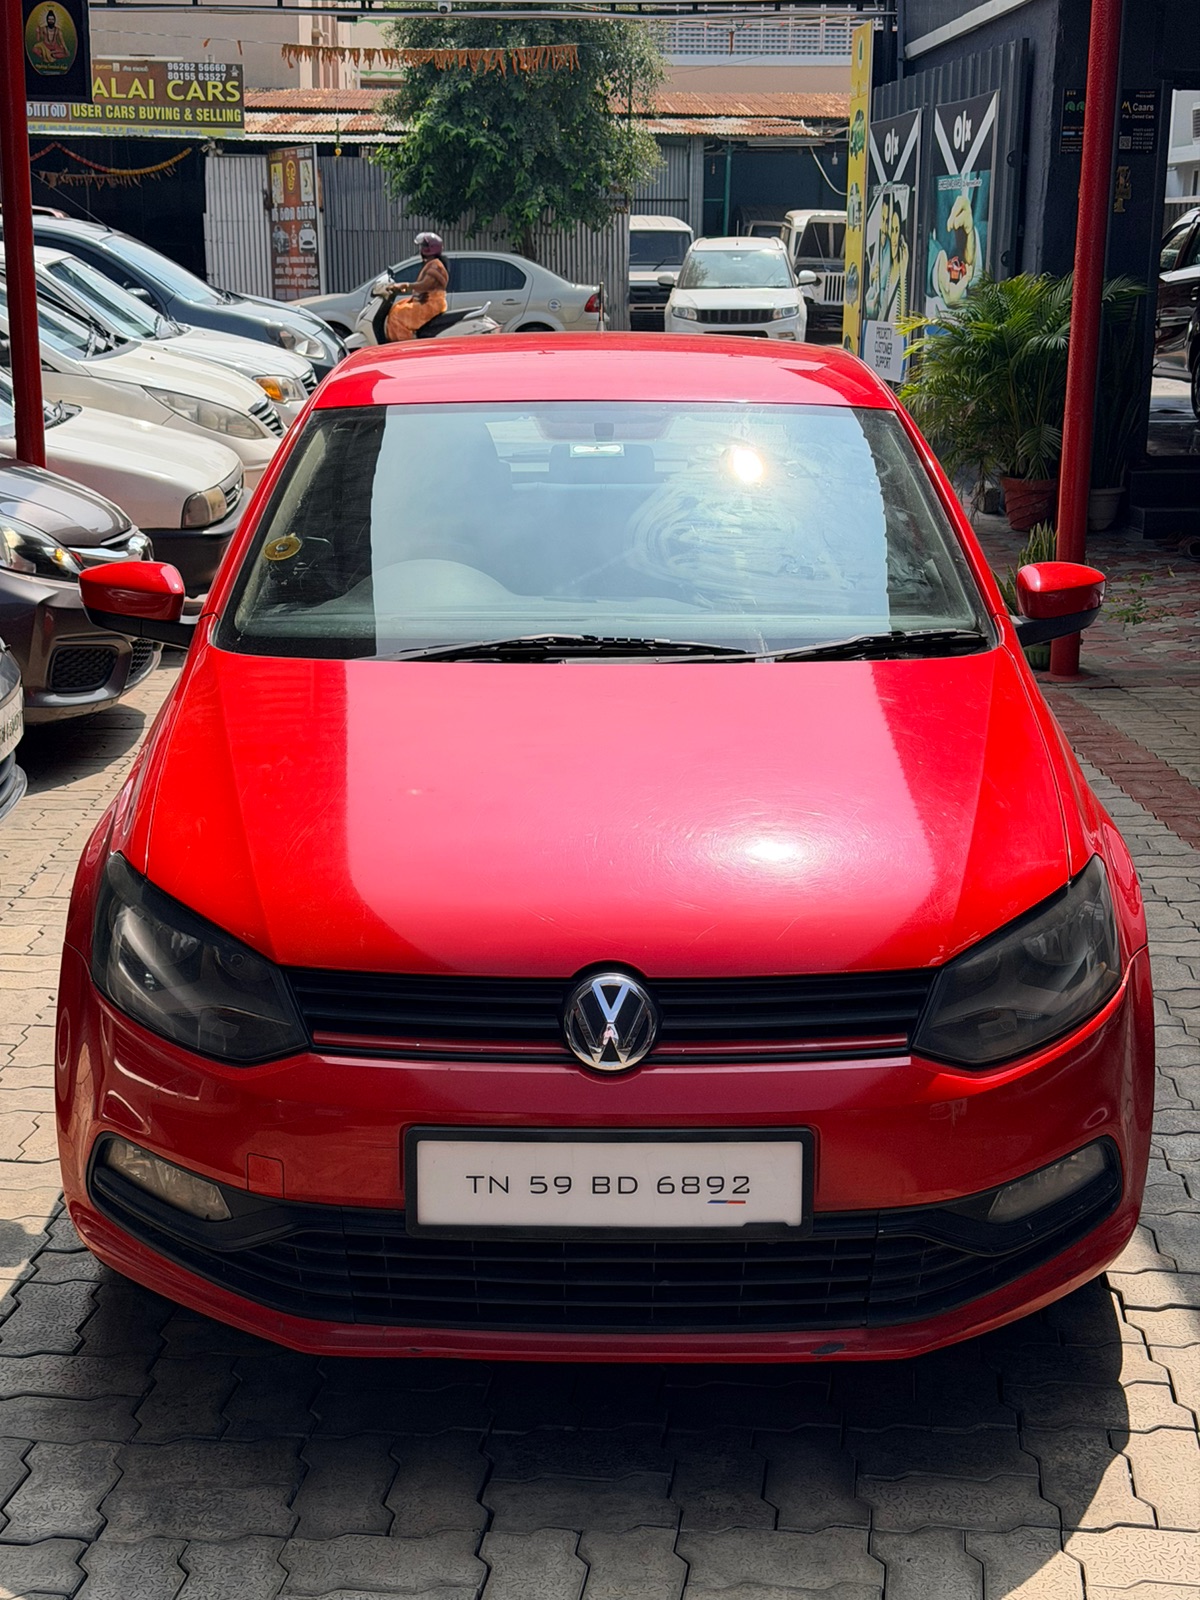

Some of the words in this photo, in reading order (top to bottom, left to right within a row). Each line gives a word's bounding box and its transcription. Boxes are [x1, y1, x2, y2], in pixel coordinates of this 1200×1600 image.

[167, 63, 195, 71] 96262
[198, 63, 226, 72] 56660
[167, 72, 196, 80] 80155
[198, 73, 226, 81] 63527
[166, 79, 241, 102] CARS
[72, 102, 102, 118] USER
[105, 103, 136, 119] CARS
[139, 104, 181, 120] BUYING
[184, 107, 193, 121] &
[196, 108, 242, 122] SELLING
[466, 1175, 509, 1194] TN
[529, 1175, 573, 1194] 59
[592, 1175, 638, 1195] BD
[656, 1175, 751, 1195] 6892
